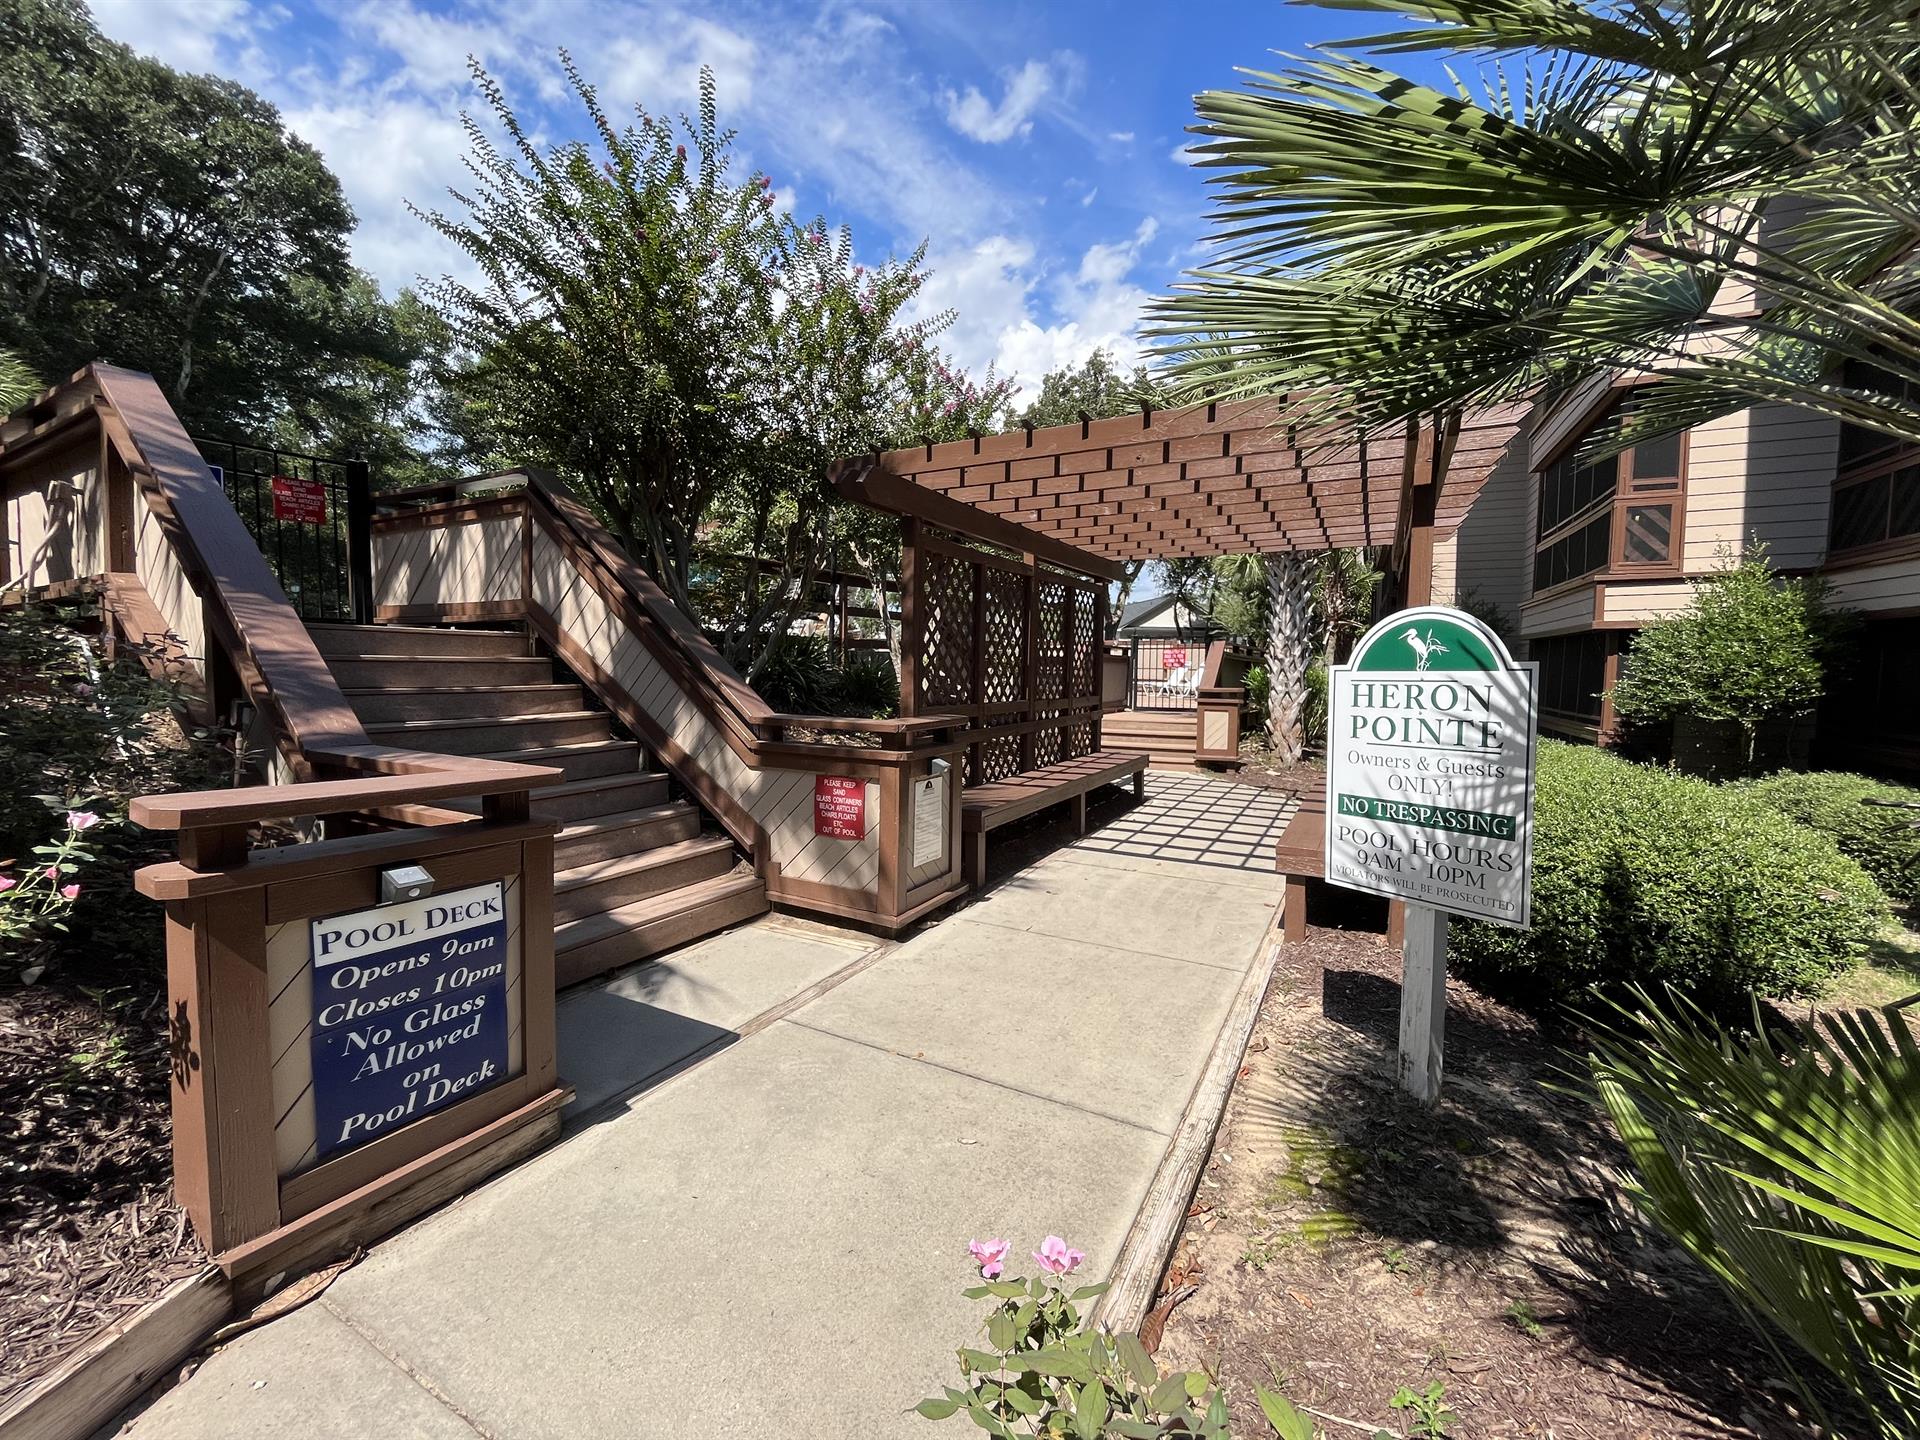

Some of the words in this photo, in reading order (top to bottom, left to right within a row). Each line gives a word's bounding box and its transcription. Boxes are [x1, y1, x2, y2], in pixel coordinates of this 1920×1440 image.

[1351, 684, 1493, 712] HERON
[1350, 714, 1504, 748] POINTE
[824, 778, 841, 787] PLEASE
[1348, 750, 1410, 769] Owners
[1417, 756, 1430, 771] &
[1437, 758, 1505, 779] Guests
[833, 797, 862, 806] CONTAINERS
[1388, 774, 1453, 798] ONLY!
[836, 805, 858, 814] ARTICLES
[1342, 797, 1368, 814] NO
[1374, 800, 1509, 835] TRESPASSING
[1338, 825, 1402, 852] POOL
[1411, 838, 1513, 872] HOURS
[1335, 864, 1390, 884] VIOLATORS
[1392, 876, 1417, 891] WILL
[1420, 883, 1433, 894] BE
[1436, 885, 1515, 912] PROSECUTED
[1357, 850, 1402, 872] 9AM
[1427, 863, 1486, 890] 10PM
[318, 918, 415, 956] POOL
[424, 896, 500, 930] DECK
[330, 950, 430, 990] Opens
[442, 935, 495, 960] 9am
[318, 986, 421, 1028] Closes
[431, 962, 503, 994] 10pm
[341, 1024, 392, 1057] No
[404, 994, 486, 1033] Glass
[350, 1014, 481, 1082] Allowed
[402, 1064, 440, 1089] on
[336, 1093, 416, 1144] Pool
[424, 1059, 496, 1107] Deck
